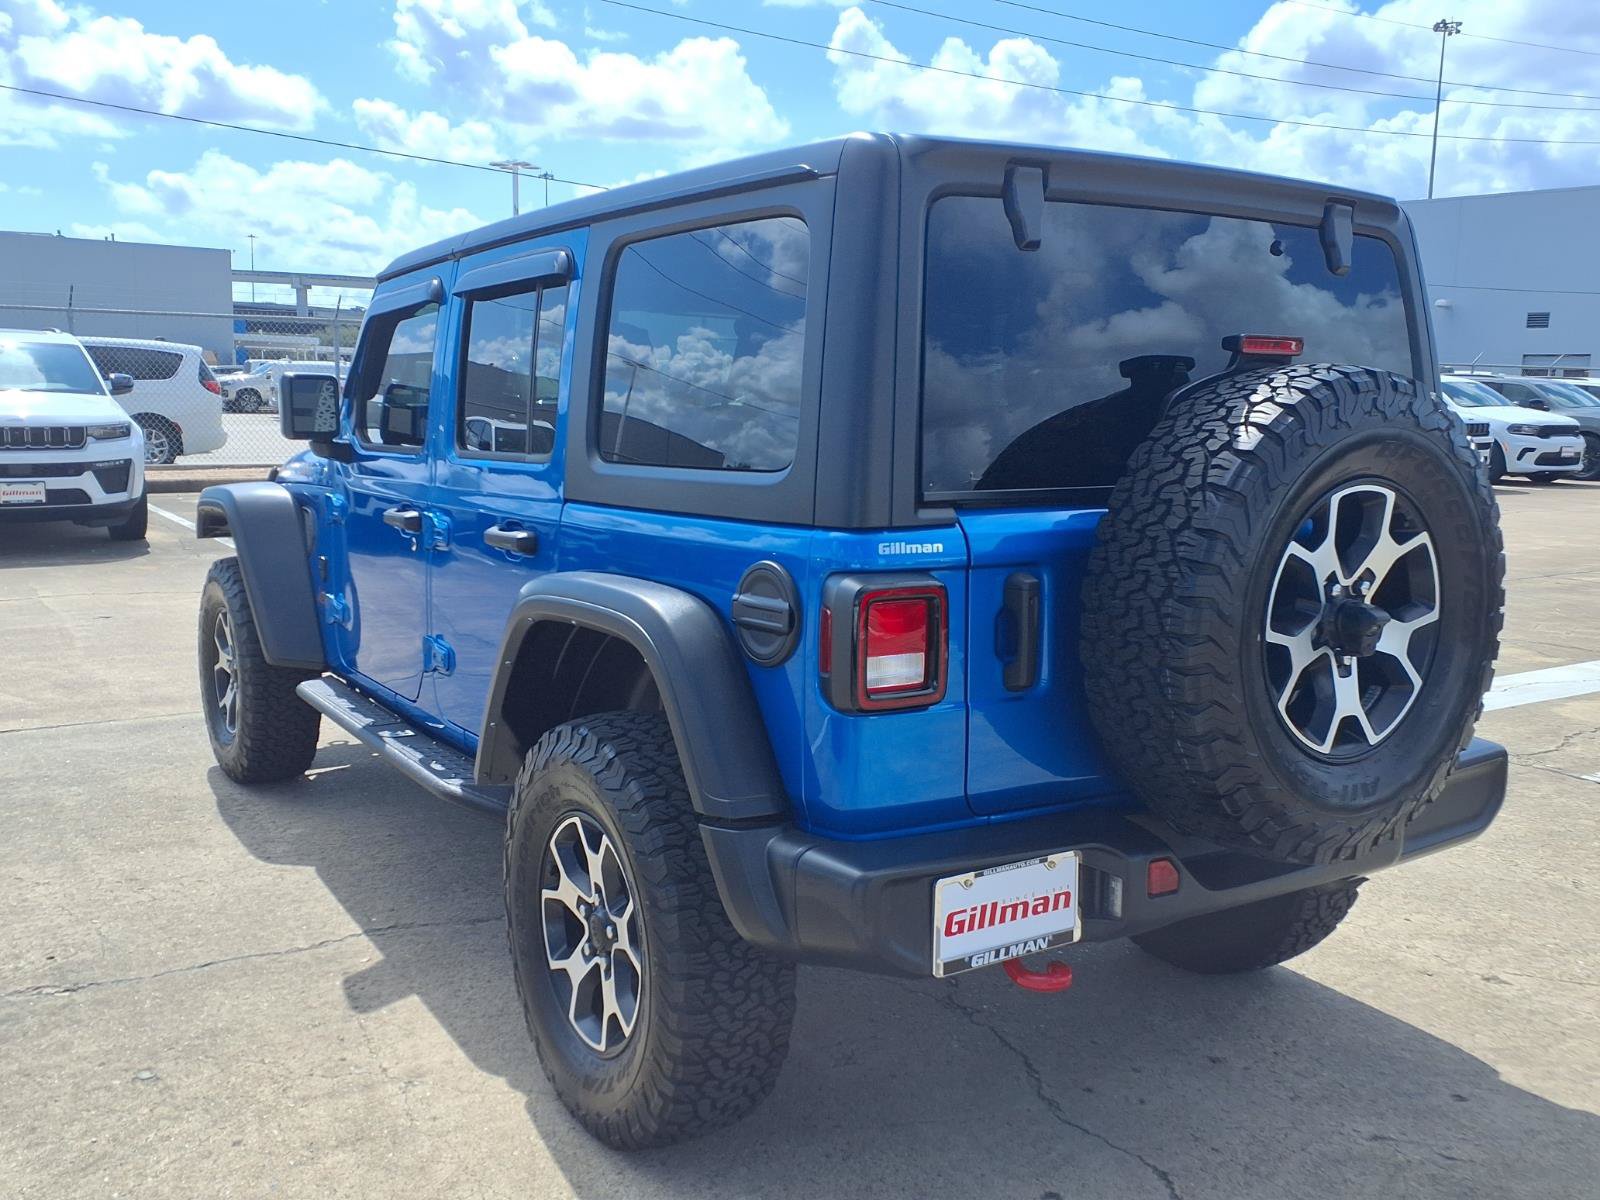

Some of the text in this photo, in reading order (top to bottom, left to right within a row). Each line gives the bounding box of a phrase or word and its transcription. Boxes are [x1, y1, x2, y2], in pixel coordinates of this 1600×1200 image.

[878, 541, 944, 555] Gillman
[944, 890, 1072, 938] Gillman
[970, 936, 1049, 968] GILLMAN
